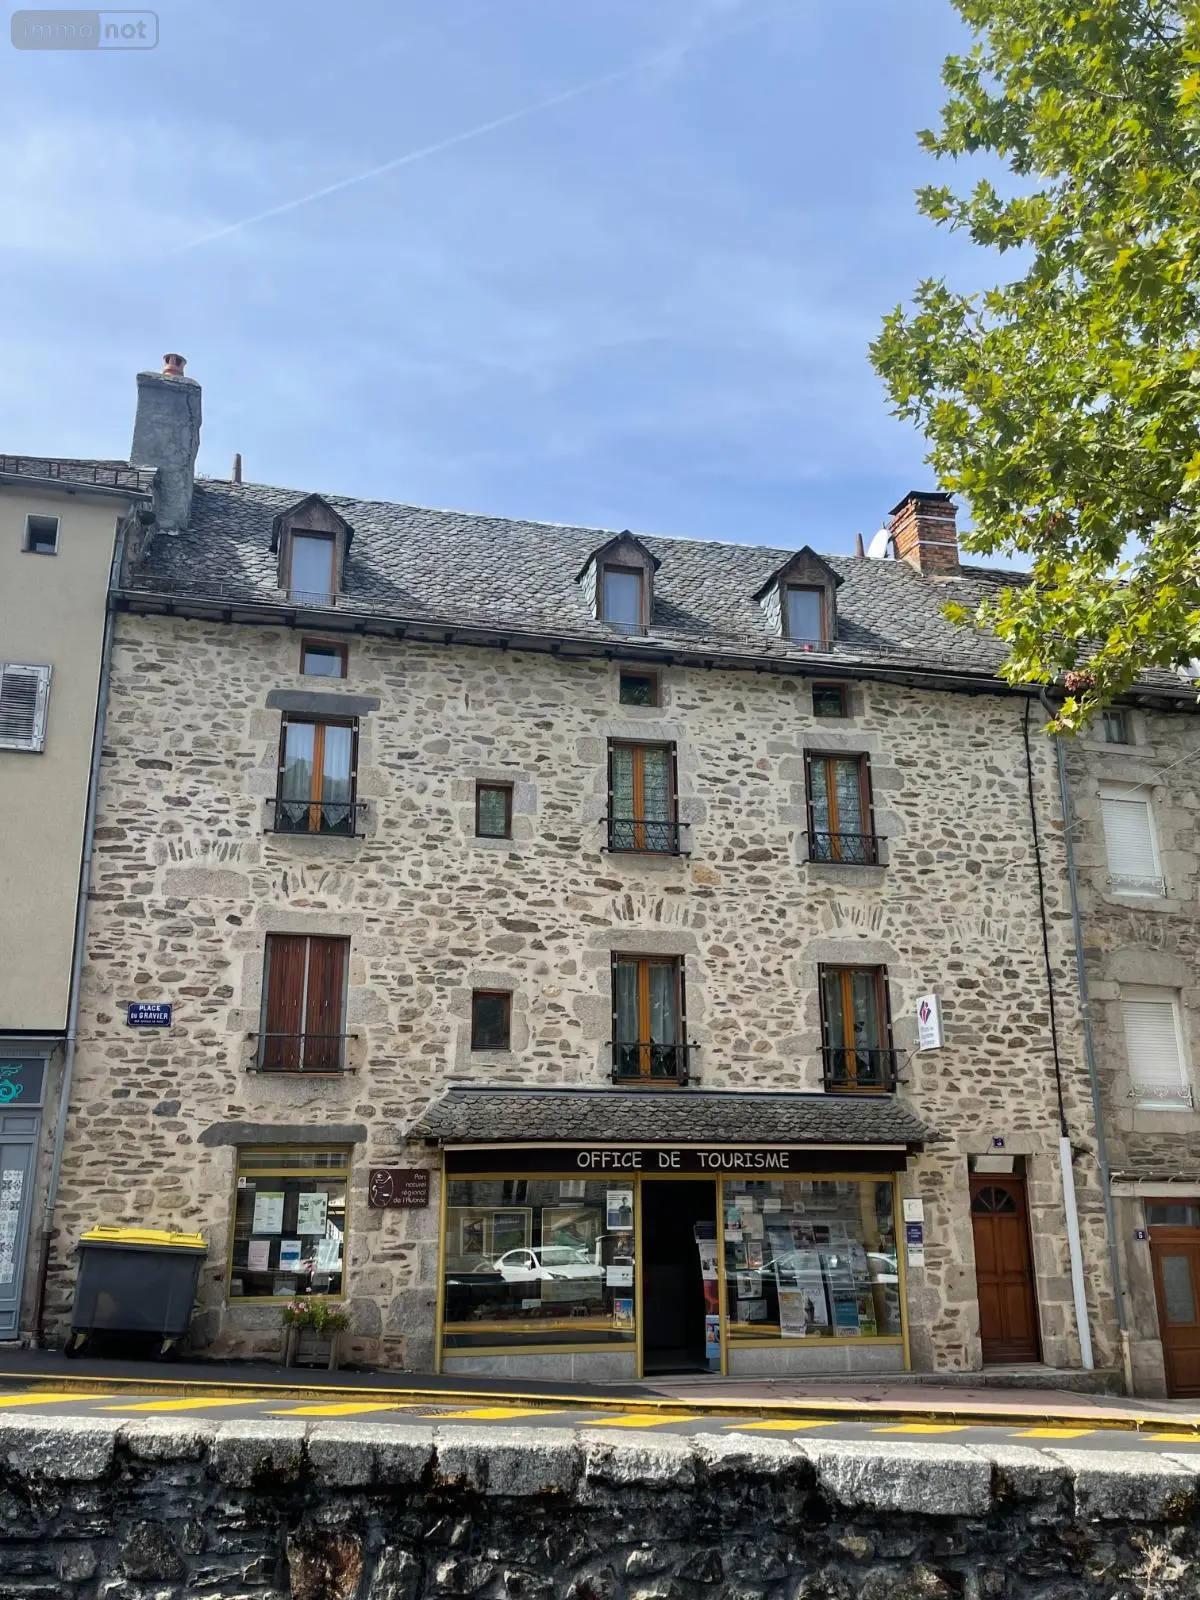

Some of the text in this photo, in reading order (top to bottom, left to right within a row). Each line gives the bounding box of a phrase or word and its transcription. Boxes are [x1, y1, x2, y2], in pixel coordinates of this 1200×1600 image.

[139, 1012, 168, 1020] GRAVIER
[576, 1151, 790, 1169] OFFICE DE TOURISME
